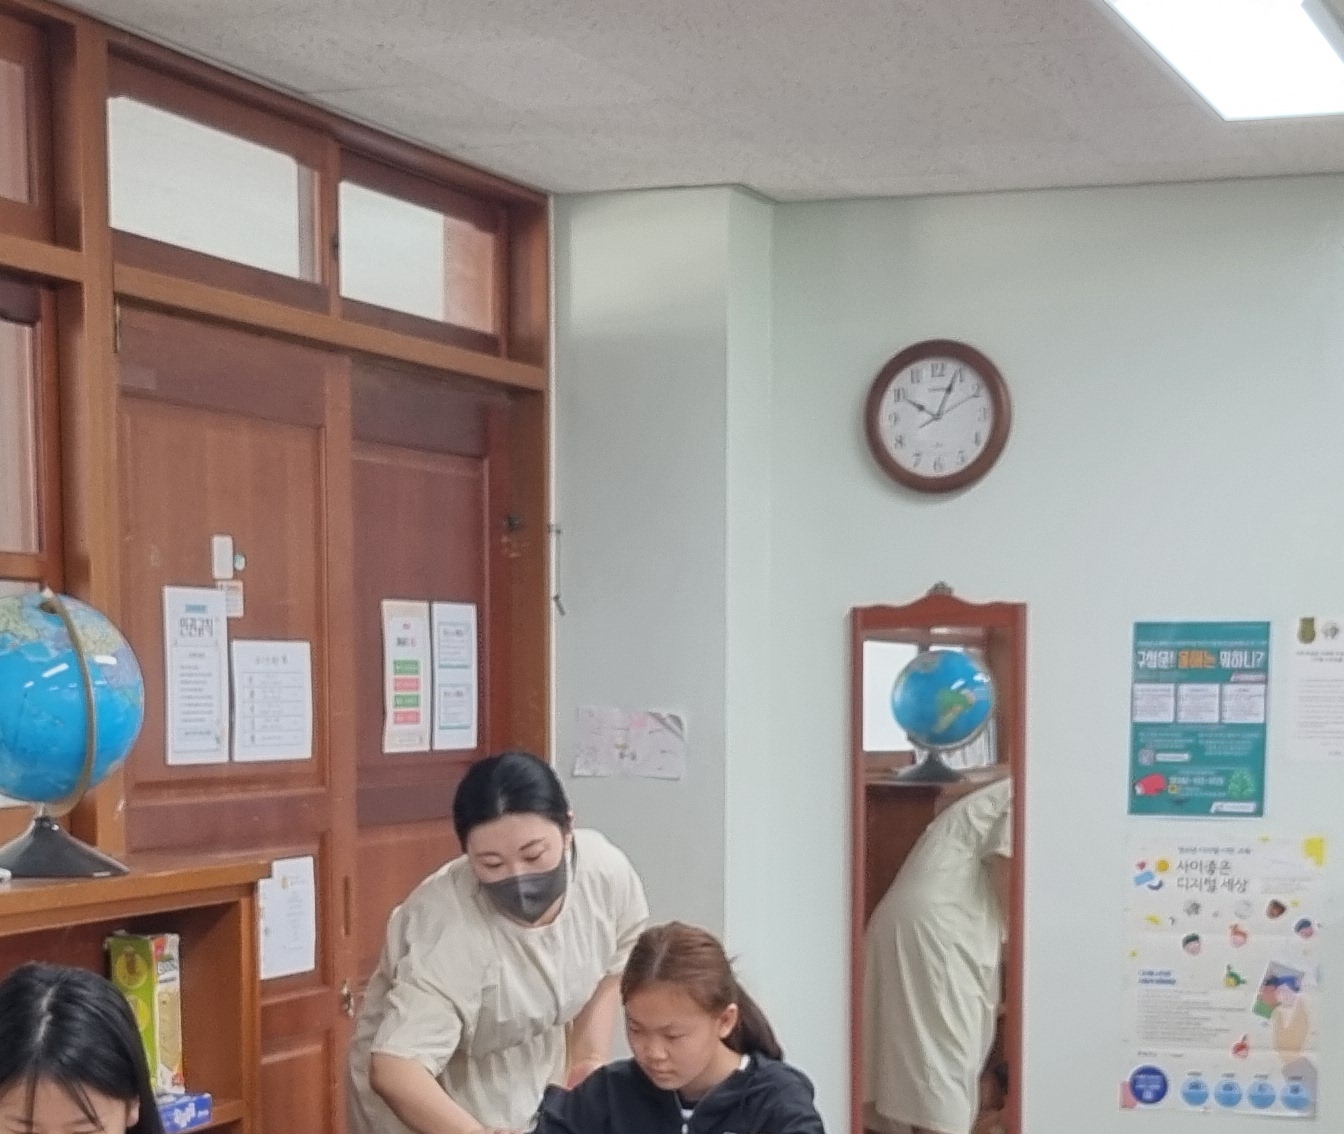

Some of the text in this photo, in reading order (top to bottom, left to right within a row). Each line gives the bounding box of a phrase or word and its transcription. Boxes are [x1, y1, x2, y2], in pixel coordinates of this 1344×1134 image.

[911, 369, 923, 384] 11
[930, 363, 945, 377] 12
[888, 412, 899, 426] 9
[977, 407, 987, 421] 3
[894, 435, 906, 449] 8
[912, 452, 923, 467] 7
[932, 456, 944, 472] 6
[956, 450, 966, 465] 5
[1177, 877, 1217, 893] 디지털
[1220, 878, 1248, 893] 세상
